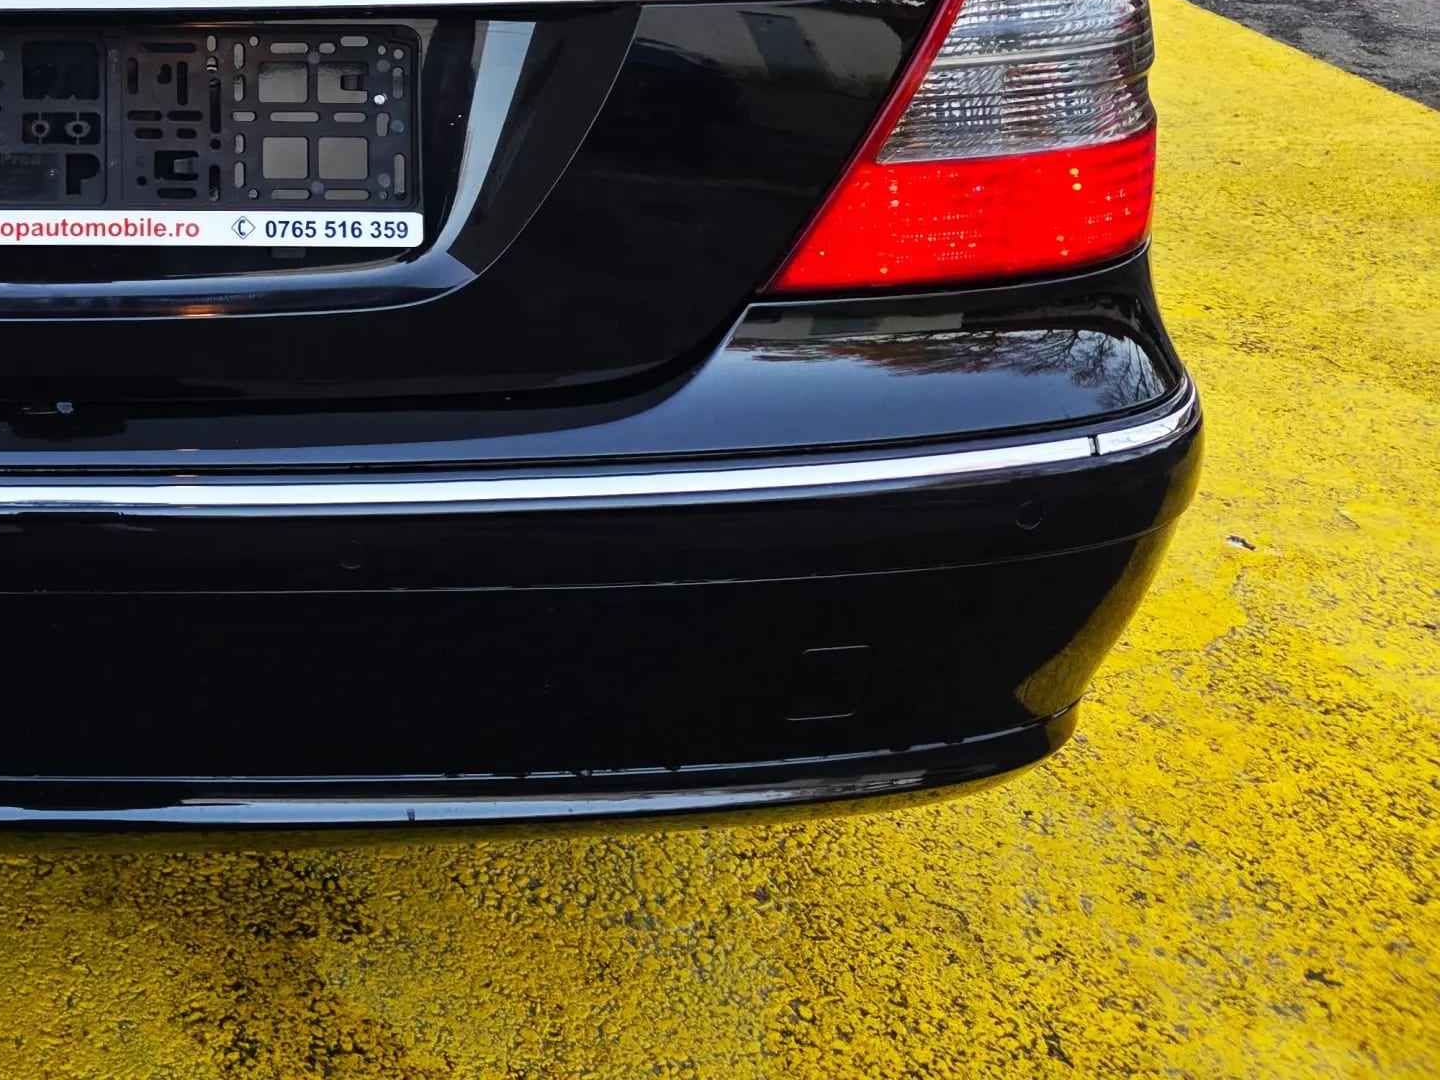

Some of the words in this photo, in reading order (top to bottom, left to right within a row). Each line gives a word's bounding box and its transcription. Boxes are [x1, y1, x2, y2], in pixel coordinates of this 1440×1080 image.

[265, 221, 317, 239] 0765
[324, 221, 362, 239] 516
[370, 221, 409, 239] 359
